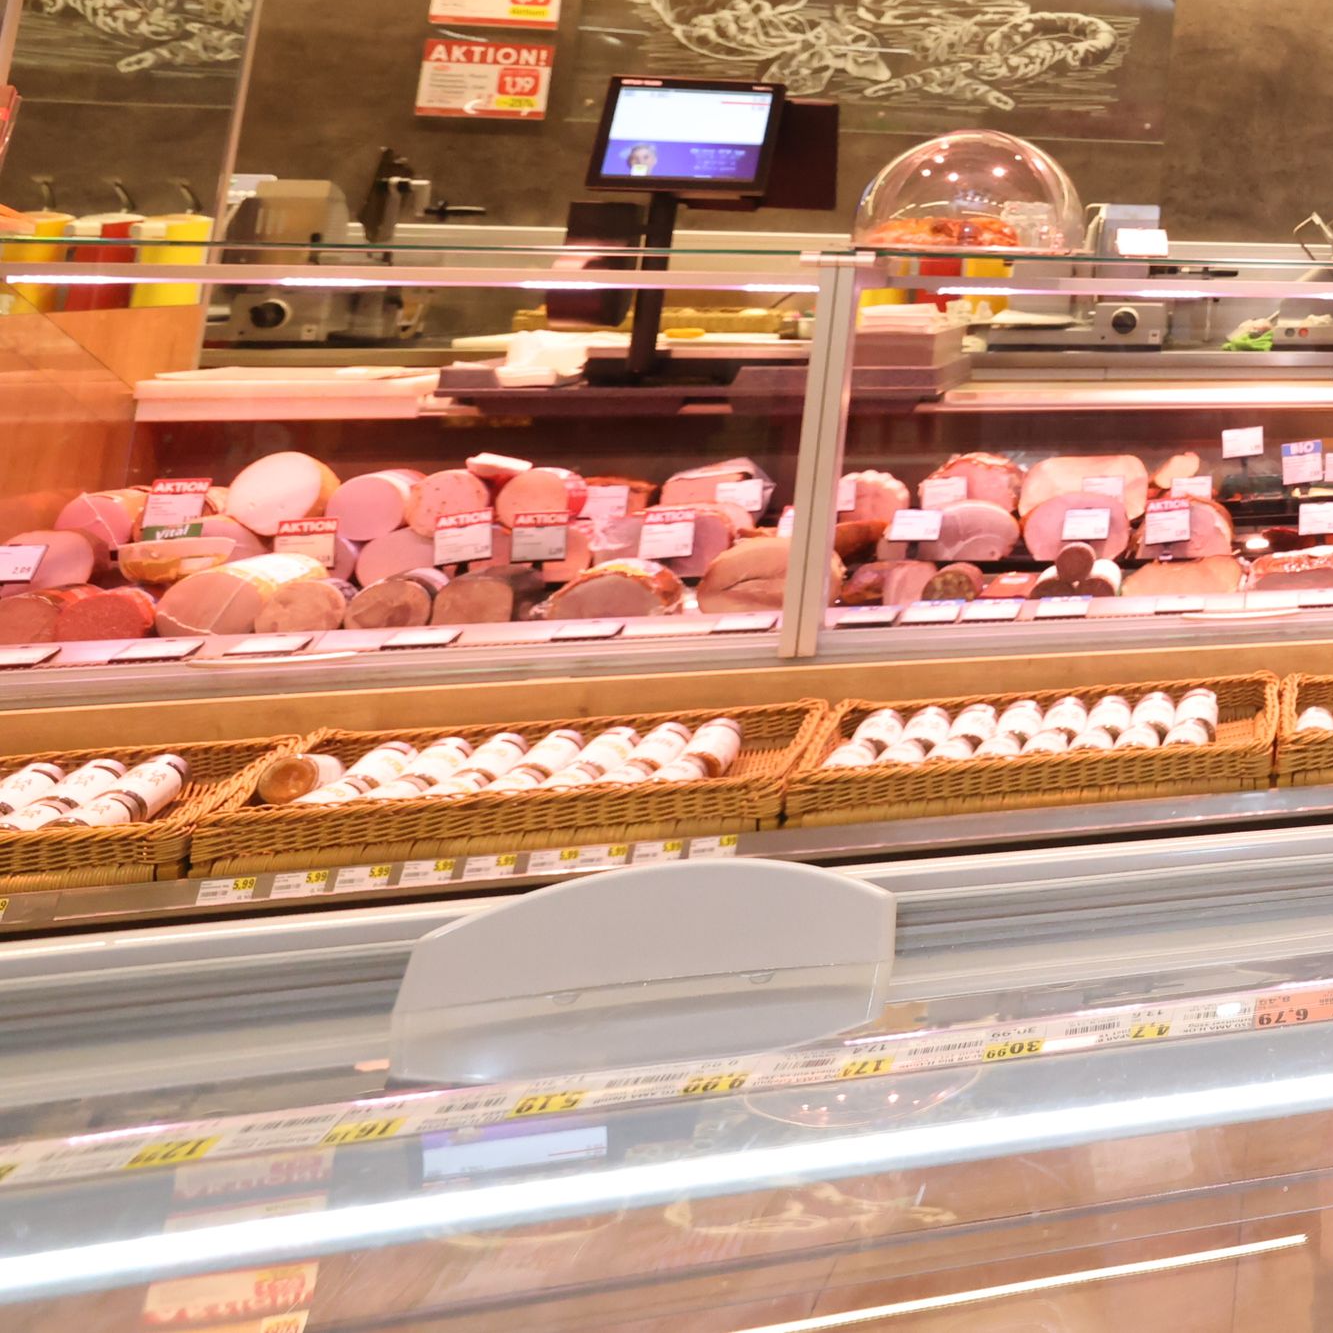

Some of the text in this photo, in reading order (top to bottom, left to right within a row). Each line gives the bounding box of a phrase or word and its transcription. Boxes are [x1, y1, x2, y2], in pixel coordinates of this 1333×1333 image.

[428, 43, 549, 67] AKTION!
[1289, 442, 1315, 454] BIO
[154, 481, 209, 494] AKTION
[437, 510, 492, 528] AKTION
[515, 514, 569, 526] AKTION
[155, 524, 190, 541] Vital
[279, 521, 337, 534] AKTION
[305, 870, 328, 884] 5,99
[368, 865, 391, 878] 5,99
[232, 878, 255, 891] 5,99
[1258, 1007, 1309, 1026] 6,79
[515, 1091, 582, 1115] 5,19
